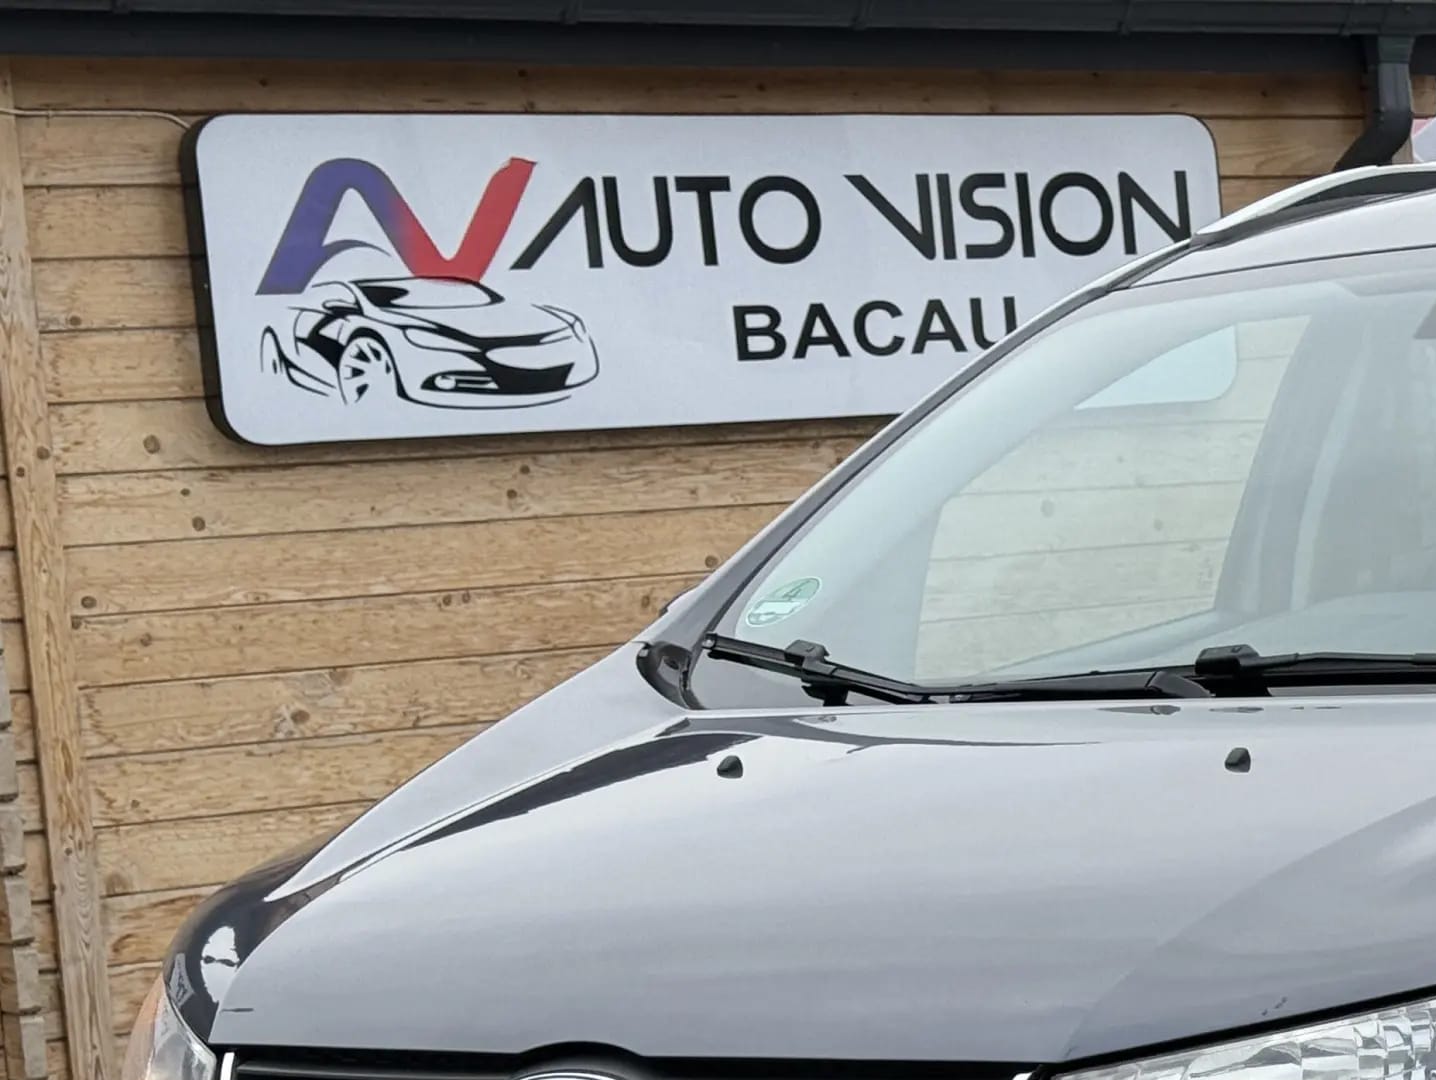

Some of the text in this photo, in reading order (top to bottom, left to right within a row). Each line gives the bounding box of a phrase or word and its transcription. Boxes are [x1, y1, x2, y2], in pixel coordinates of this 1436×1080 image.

[509, 174, 822, 271] AUTO
[844, 169, 1192, 260] VISION
[733, 296, 1018, 362] BACAU
